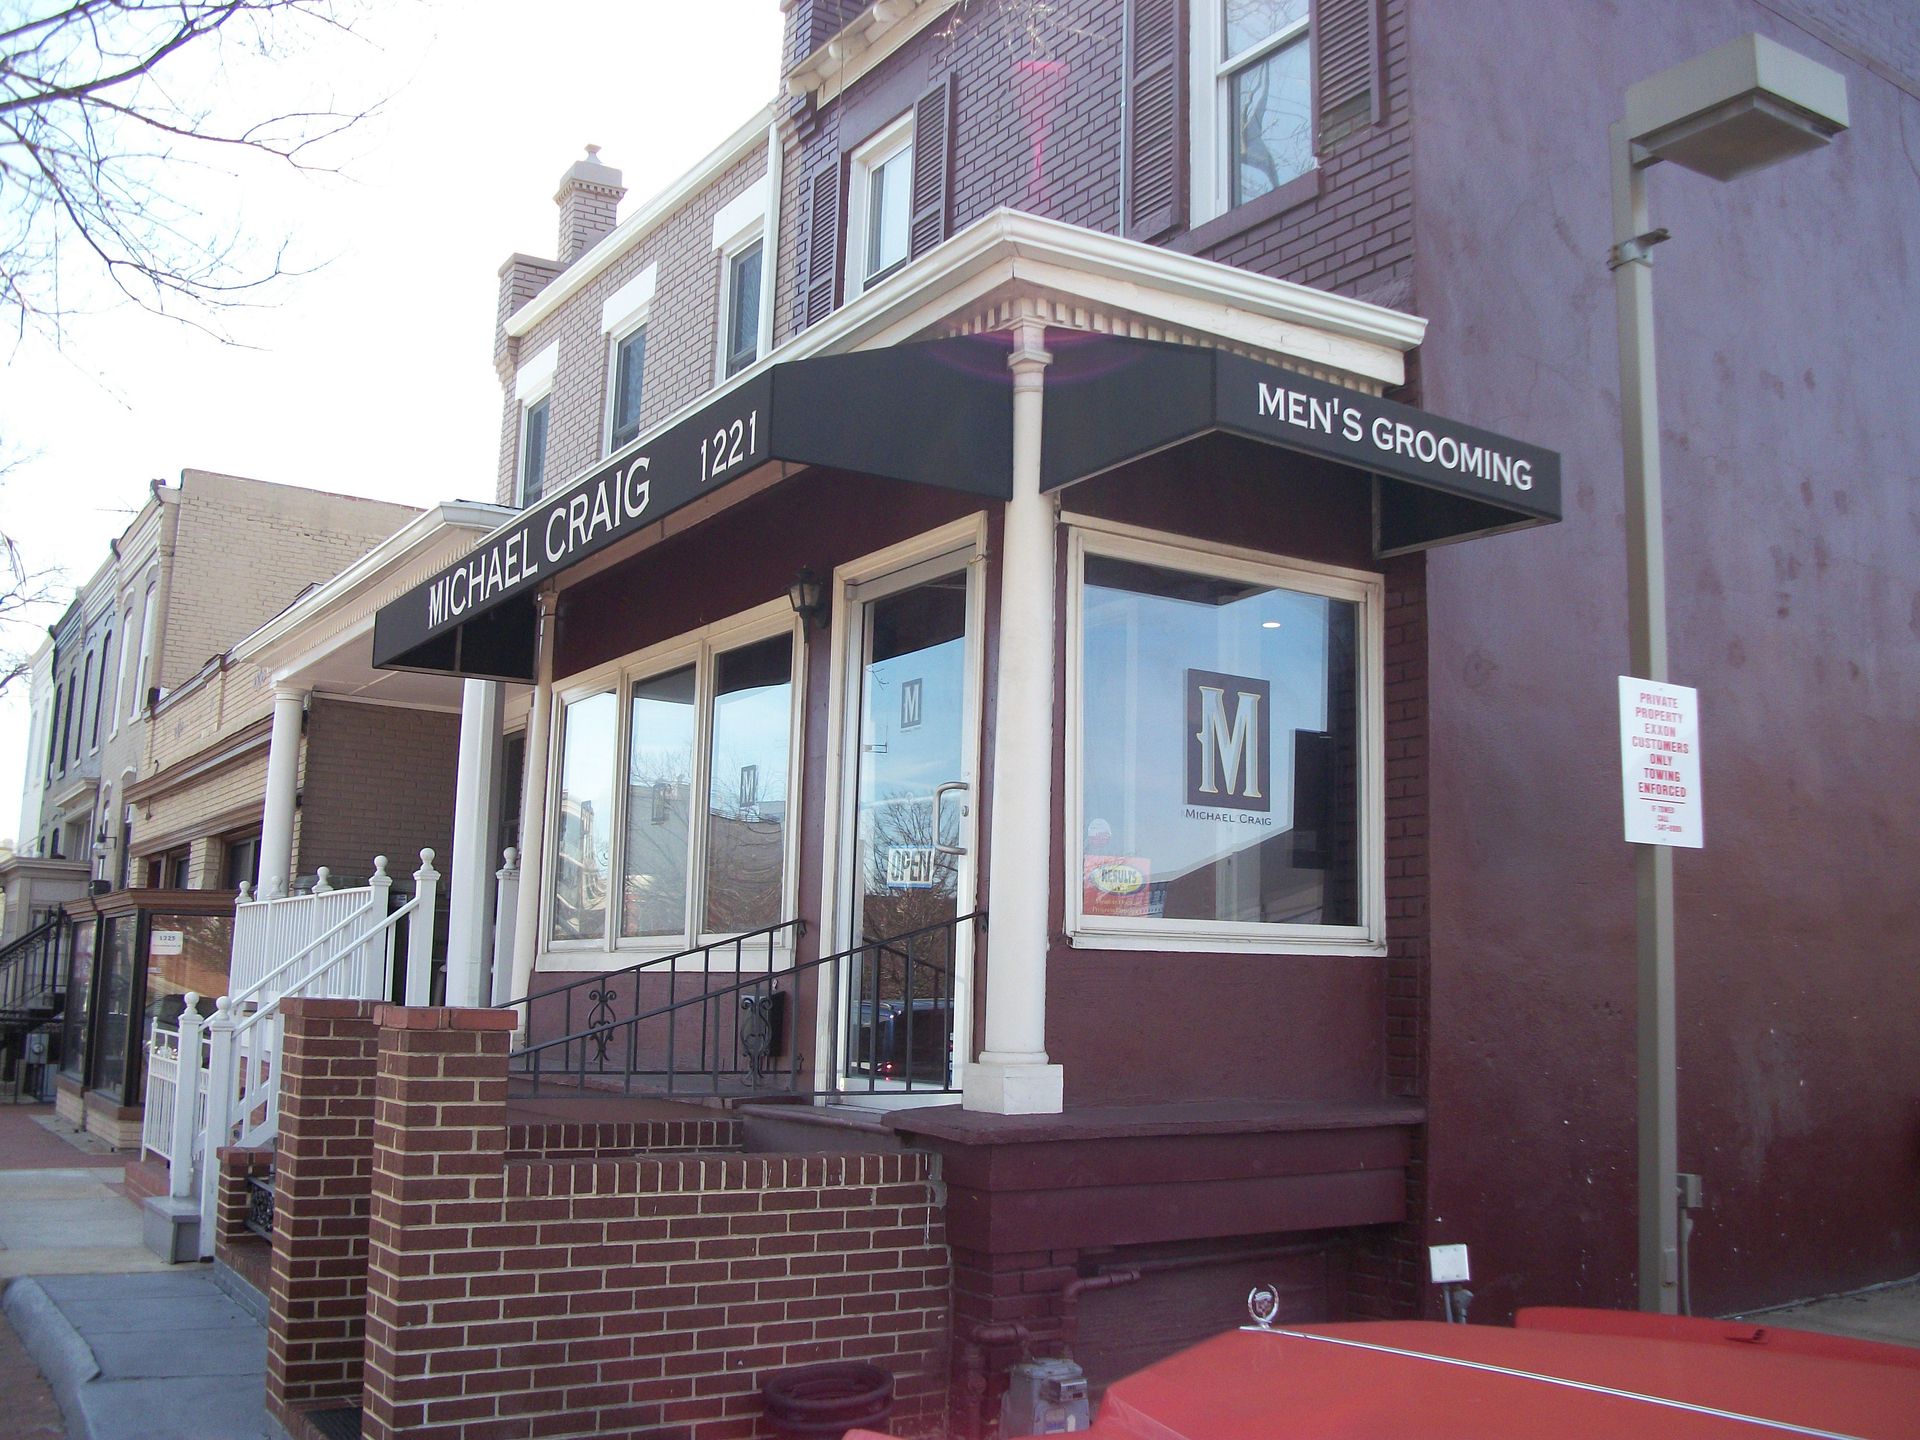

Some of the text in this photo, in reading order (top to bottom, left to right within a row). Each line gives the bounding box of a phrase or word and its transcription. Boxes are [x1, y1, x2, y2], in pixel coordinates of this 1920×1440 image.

[1258, 382, 1533, 491] MEN'S GROOMING
[700, 409, 757, 482] 1221
[427, 456, 651, 630] MICHAEL CRAIG
[1640, 692, 1678, 708] PRIVATE
[1635, 706, 1683, 723] PROPERTY
[1645, 723, 1676, 737] EXXON
[1196, 685, 1262, 798] M
[1632, 736, 1689, 754] CUSTOMERS
[1650, 753, 1673, 766] ONLY
[1644, 768, 1681, 782] TOWING
[1638, 782, 1687, 798] ENFORCED
[1185, 808, 1272, 825] MICHAEL CRAIG
[891, 849, 932, 882] OPEN
[1101, 867, 1137, 884] RESULTS
